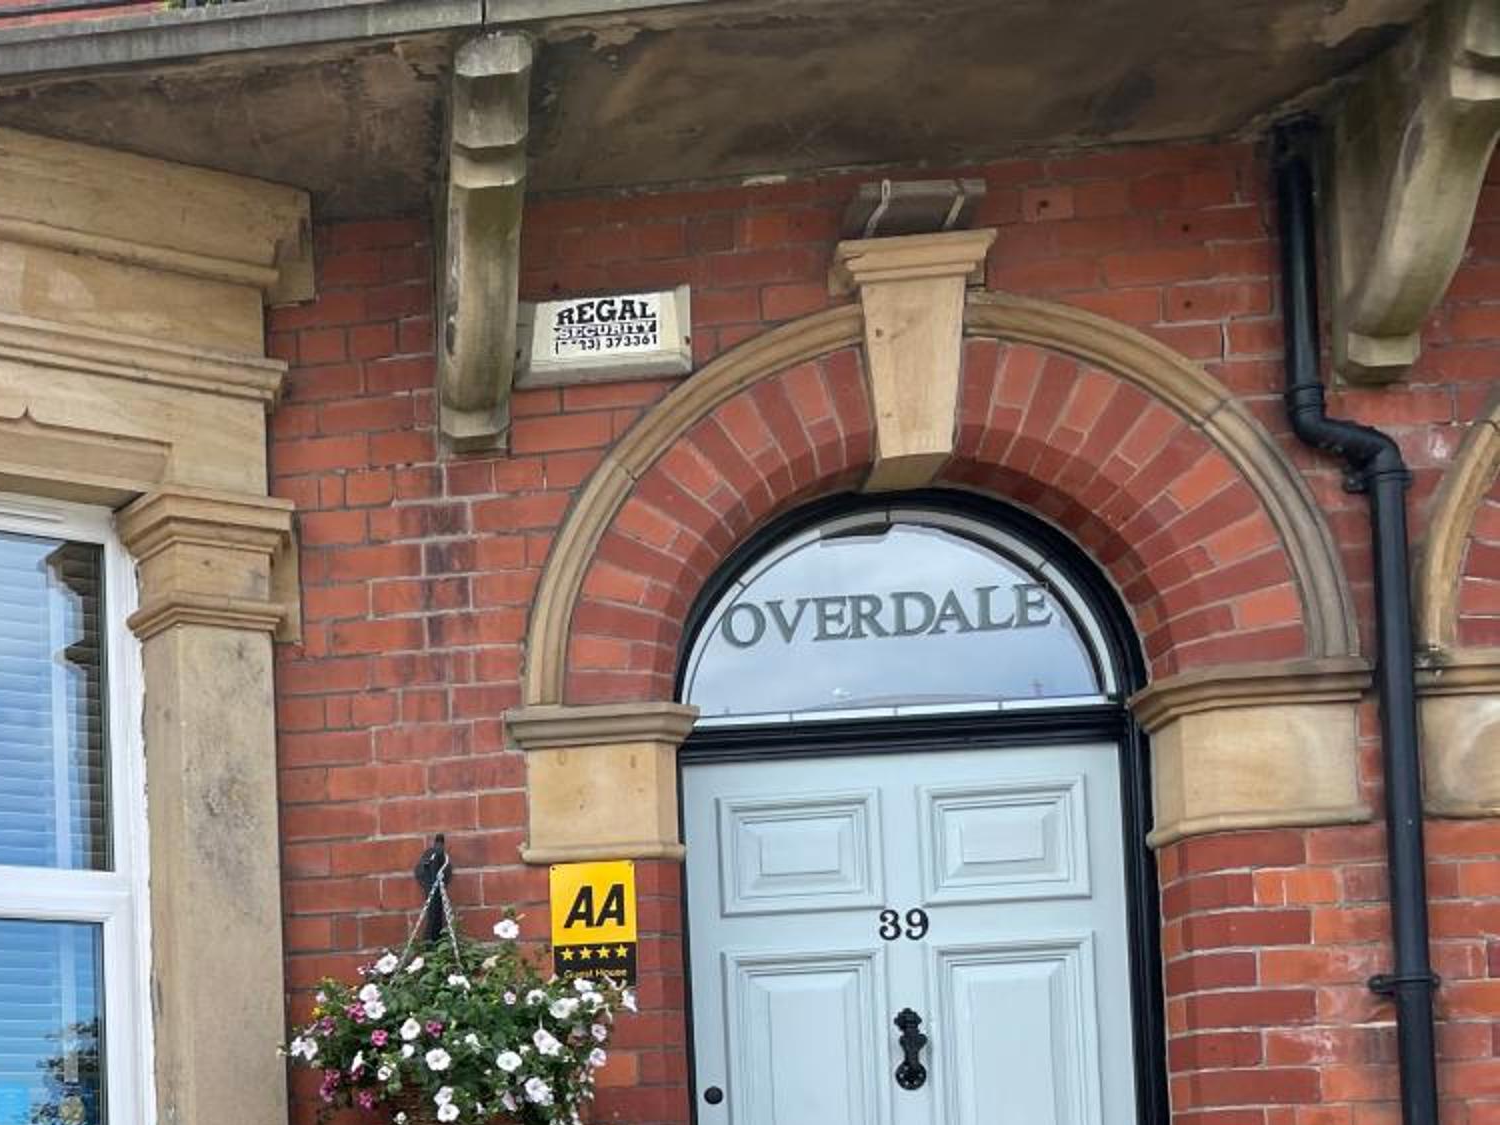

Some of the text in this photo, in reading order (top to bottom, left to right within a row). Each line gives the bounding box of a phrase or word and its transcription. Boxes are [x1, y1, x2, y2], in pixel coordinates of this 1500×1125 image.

[556, 300, 657, 326] REGAL
[558, 321, 656, 339] SECURITY
[606, 334, 657, 349] 373361
[720, 583, 1054, 649] OVERDALE
[563, 883, 625, 929] AA
[879, 907, 929, 941] 39
